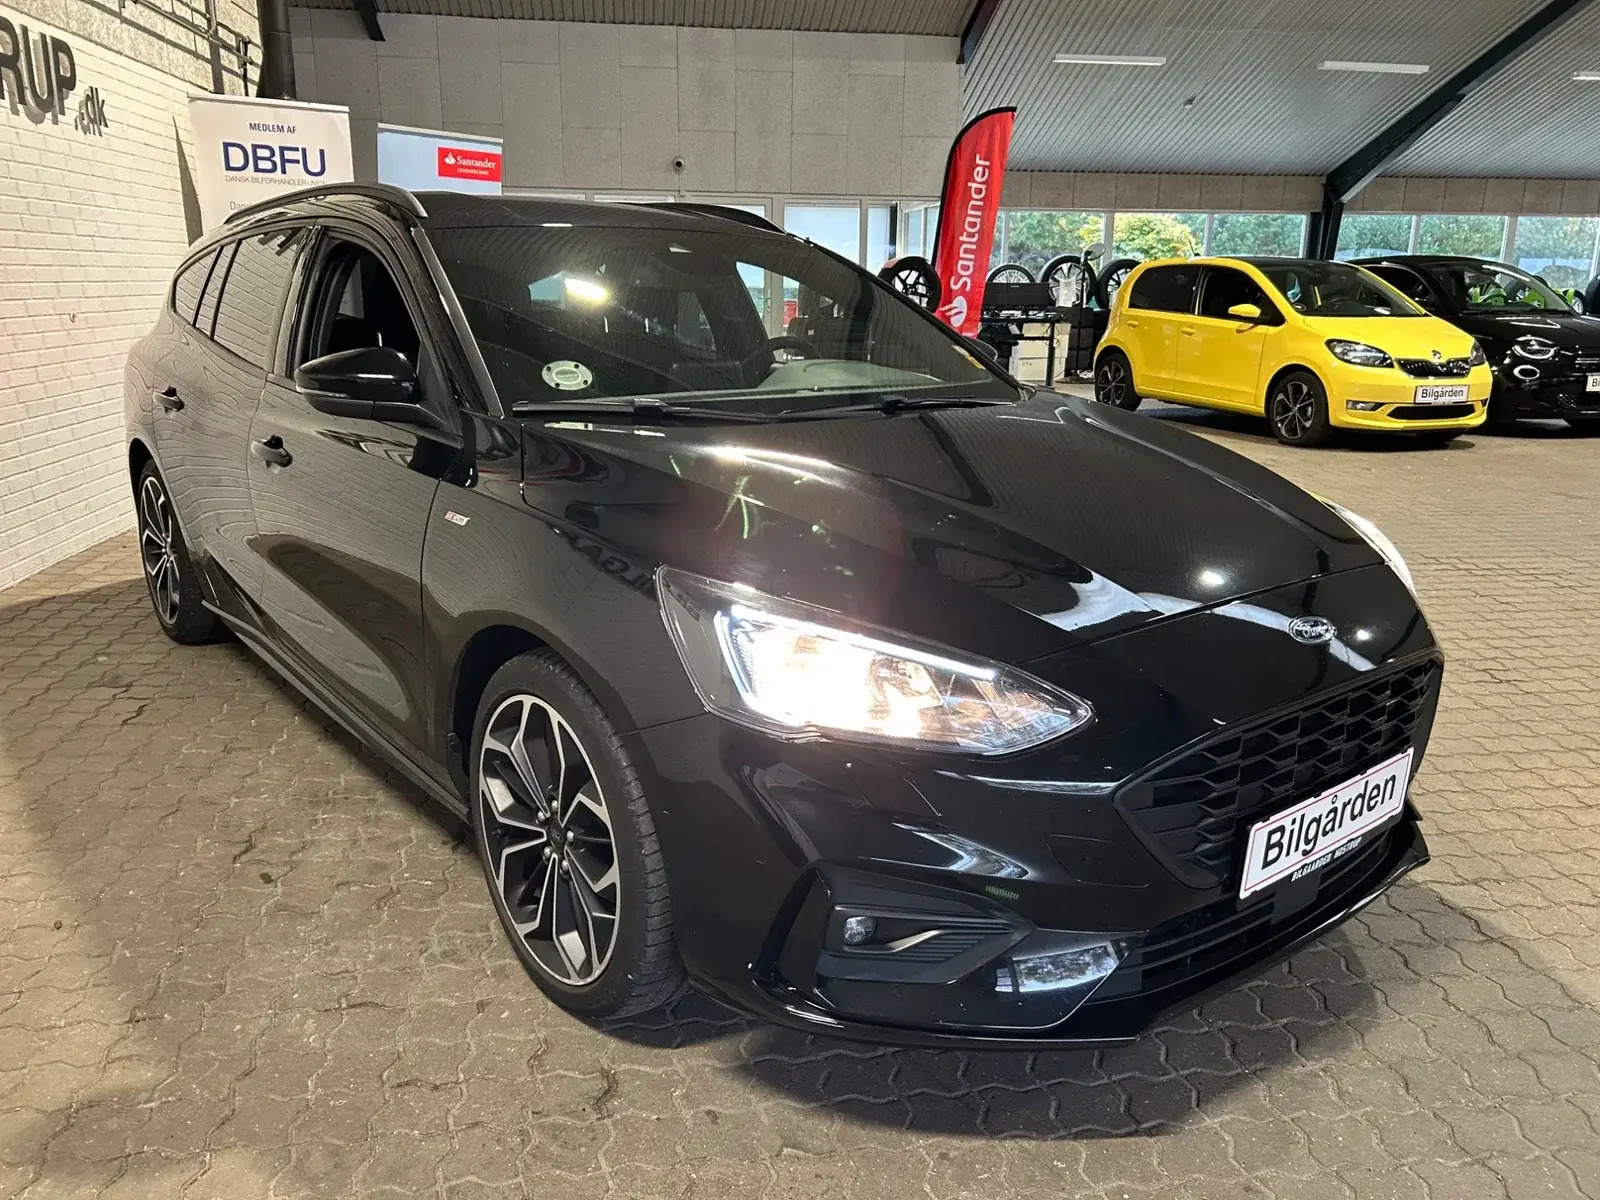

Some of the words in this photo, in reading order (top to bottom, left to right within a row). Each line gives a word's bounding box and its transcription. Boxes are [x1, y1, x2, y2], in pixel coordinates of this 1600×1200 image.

[249, 122, 285, 133] MEDLEM
[286, 126, 297, 135] AF
[222, 141, 327, 177] DBFU
[457, 155, 496, 168] Santander
[225, 175, 250, 184] DANSK
[251, 177, 306, 186] BILFORHANDLER
[950, 154, 991, 292] Santander
[1421, 387, 1464, 402] Bilgården
[1261, 773, 1397, 870] Bilgården
